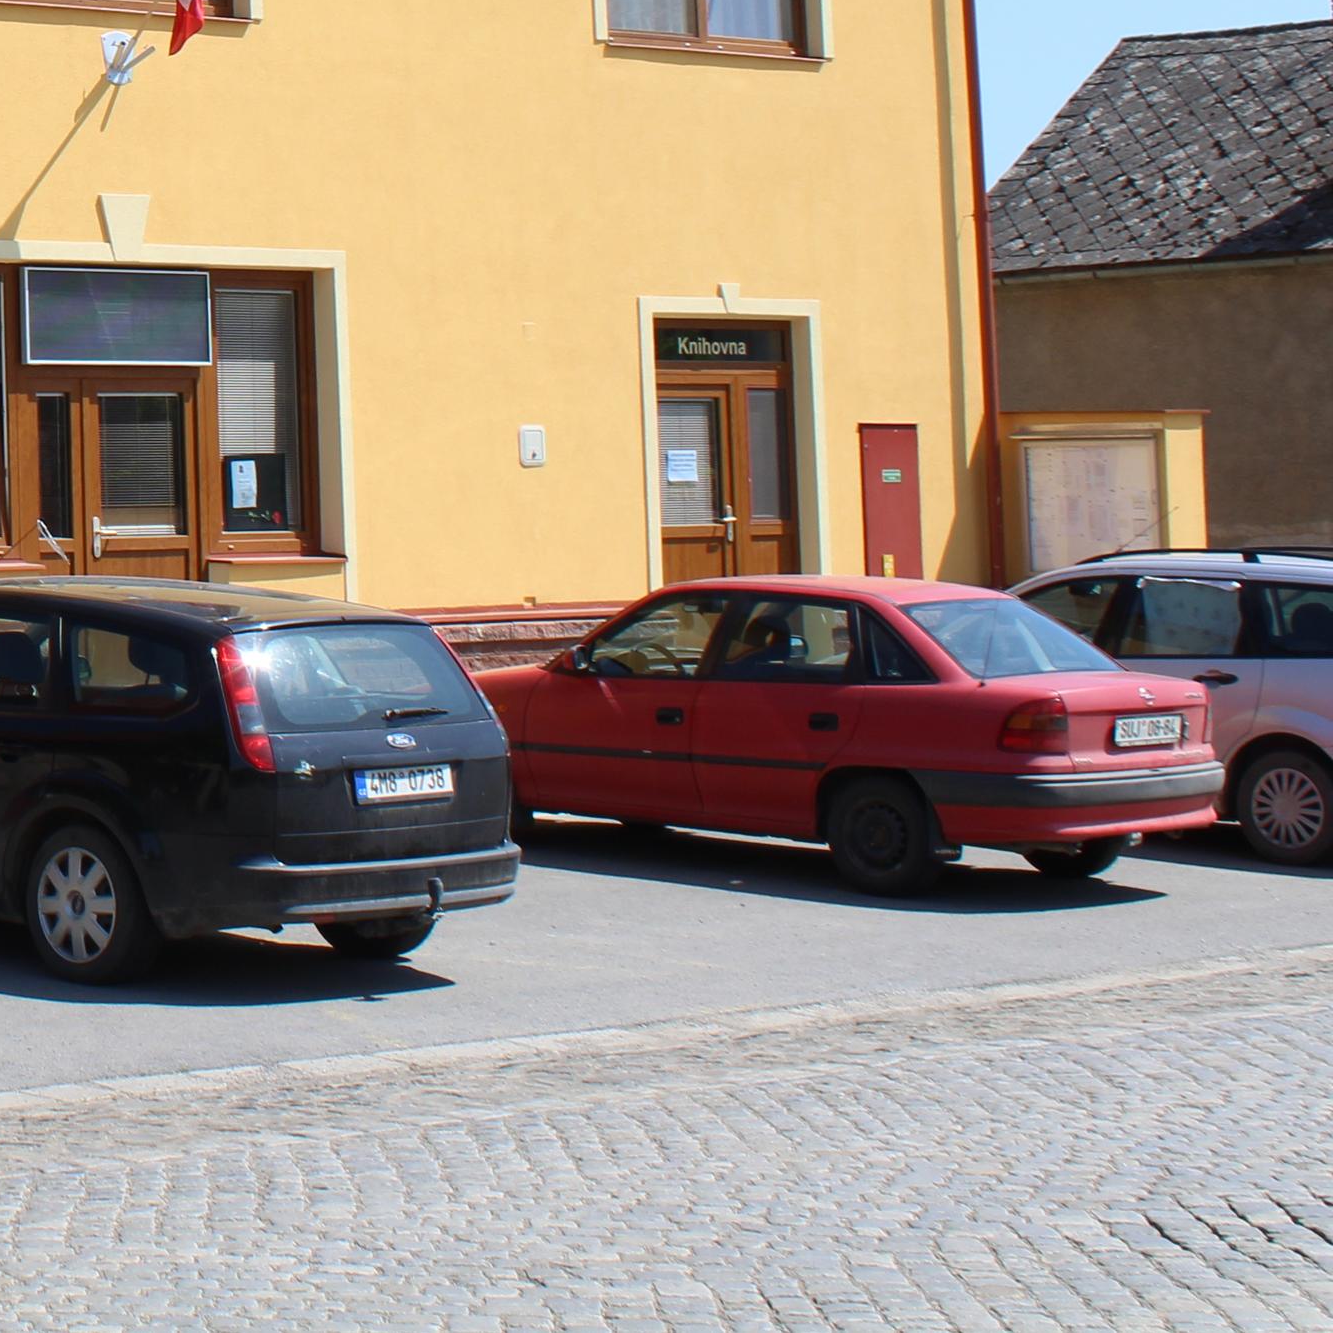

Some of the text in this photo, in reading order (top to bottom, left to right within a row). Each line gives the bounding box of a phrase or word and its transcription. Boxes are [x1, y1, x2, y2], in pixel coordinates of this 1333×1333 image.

[678, 336, 747, 355] Knihovna
[370, 767, 445, 794] 4M8 0738
